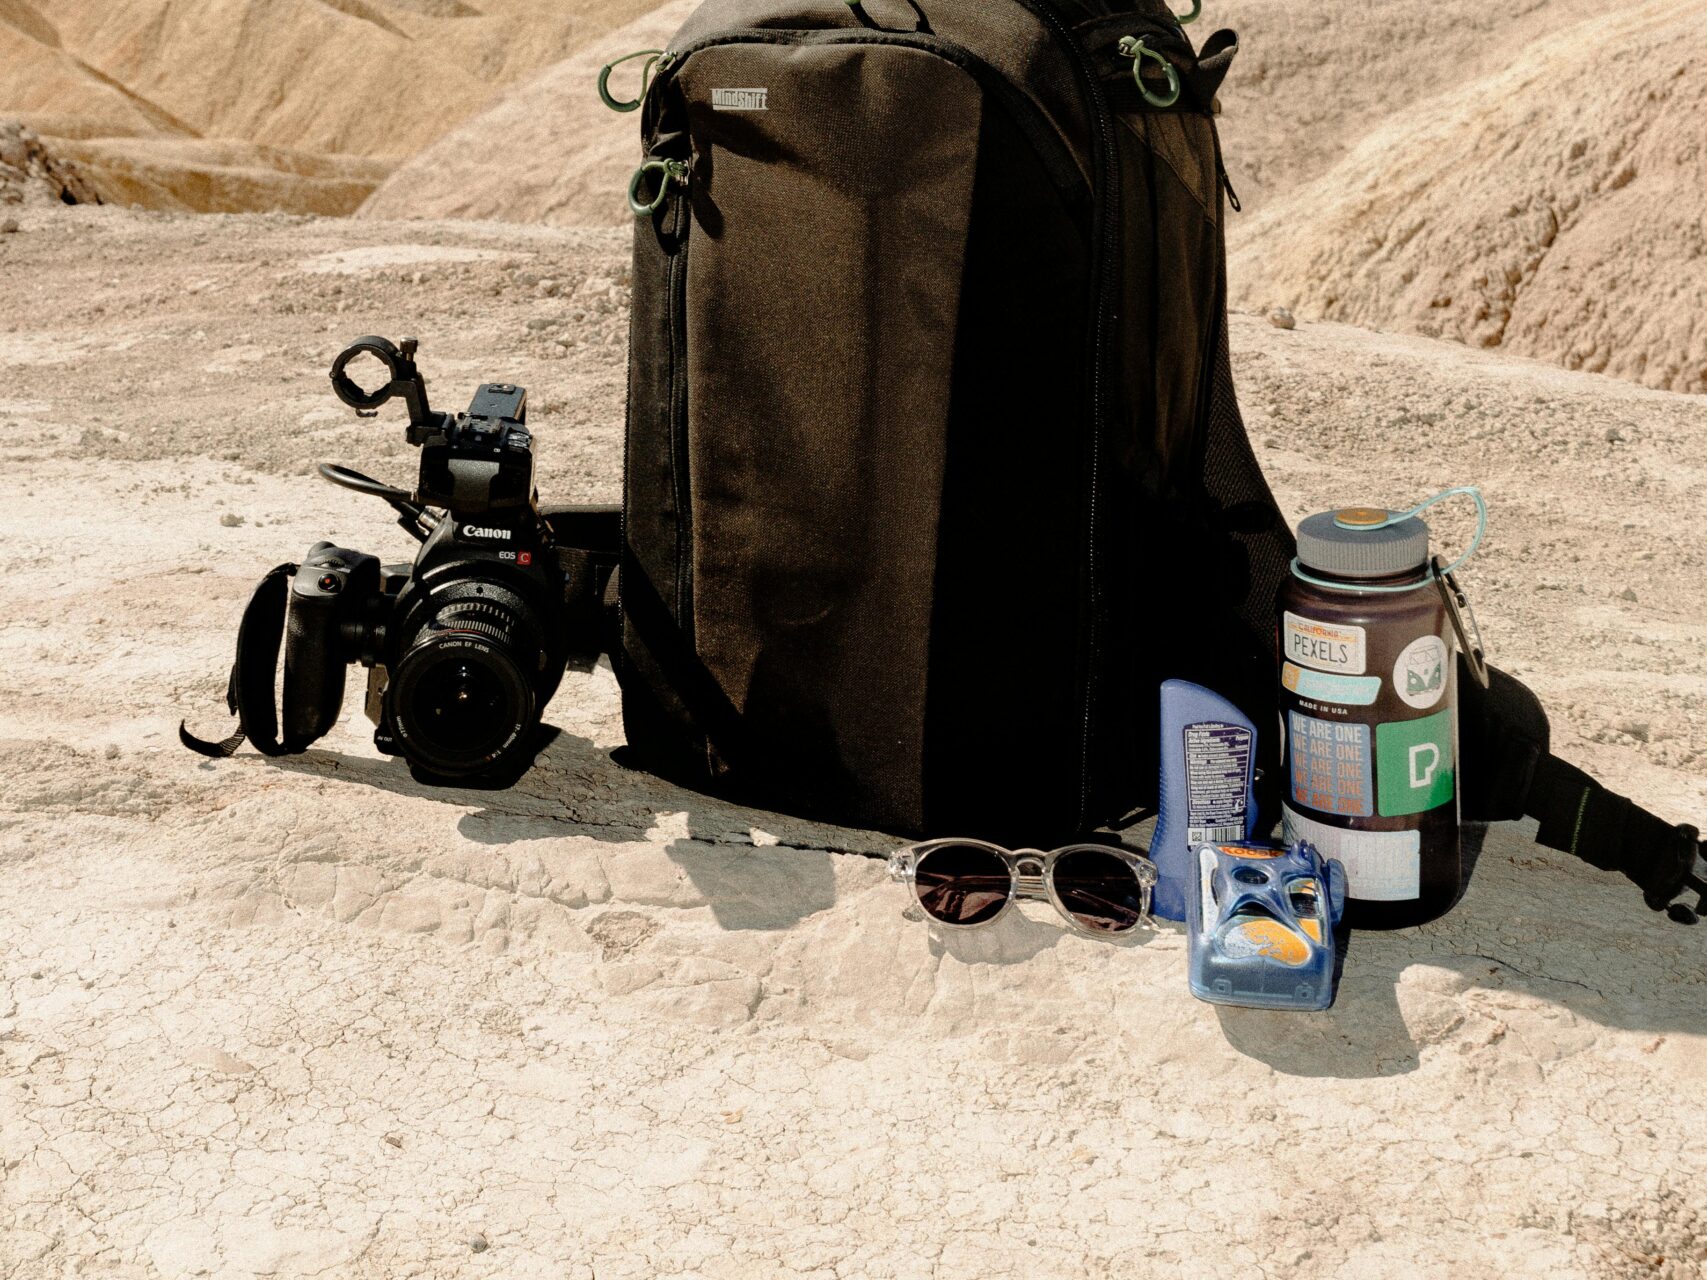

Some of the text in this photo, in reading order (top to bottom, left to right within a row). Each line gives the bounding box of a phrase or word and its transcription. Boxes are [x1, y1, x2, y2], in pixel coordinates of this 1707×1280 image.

[711, 88, 768, 110] MindShift
[463, 525, 511, 540] Canon
[499, 551, 516, 560] EOS
[1299, 624, 1339, 638] CALIFORNIA
[439, 641, 462, 649] CANON
[474, 643, 490, 653] LENS
[1294, 633, 1348, 664] PEXELS
[1299, 700, 1348, 715] MADE IN USA
[1292, 714, 1362, 743] WE ARE ONE
[1293, 732, 1362, 761] WE ARE ONE
[1294, 751, 1362, 779] WE ARE ONE
[1295, 769, 1363, 796] WE ARE ONE
[1296, 786, 1364, 815] WE ARE ONE
